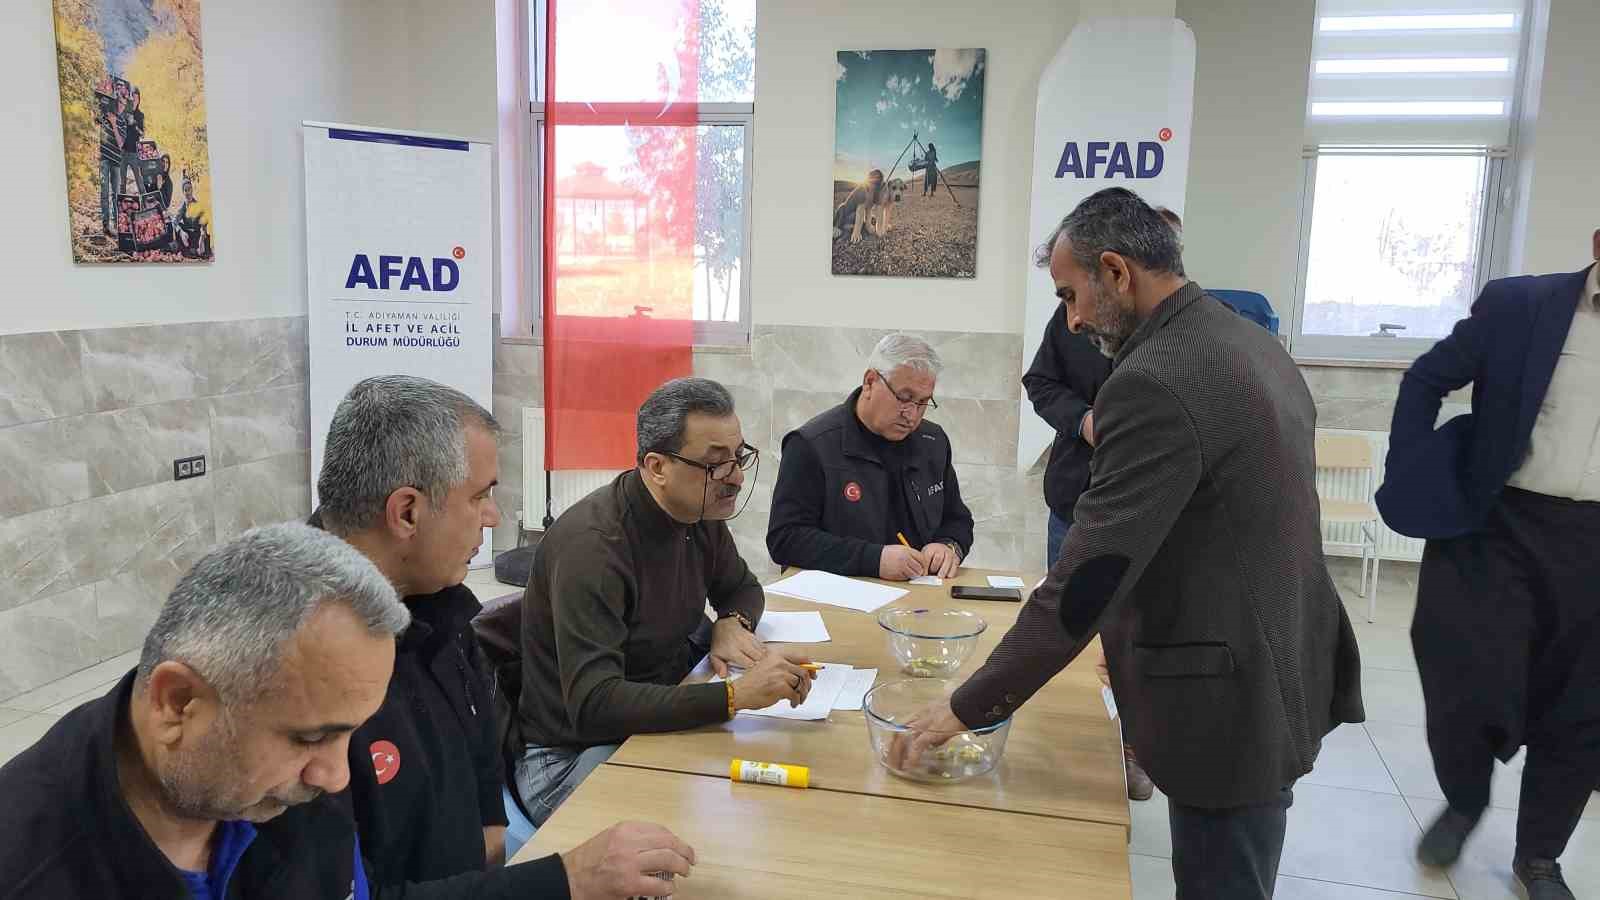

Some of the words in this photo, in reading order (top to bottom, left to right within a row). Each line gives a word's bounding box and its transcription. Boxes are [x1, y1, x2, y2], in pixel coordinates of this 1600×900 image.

[1054, 141, 1164, 179] AFAD
[345, 254, 460, 292] AFAD
[368, 311, 418, 321] ADIYAMAN
[346, 320, 359, 333] İL
[366, 323, 401, 334] AFET
[407, 324, 424, 334] VE
[431, 321, 461, 334] ACİL
[346, 336, 388, 347] DURUM
[393, 335, 460, 348] MÜDÜRLÜĞÜ
